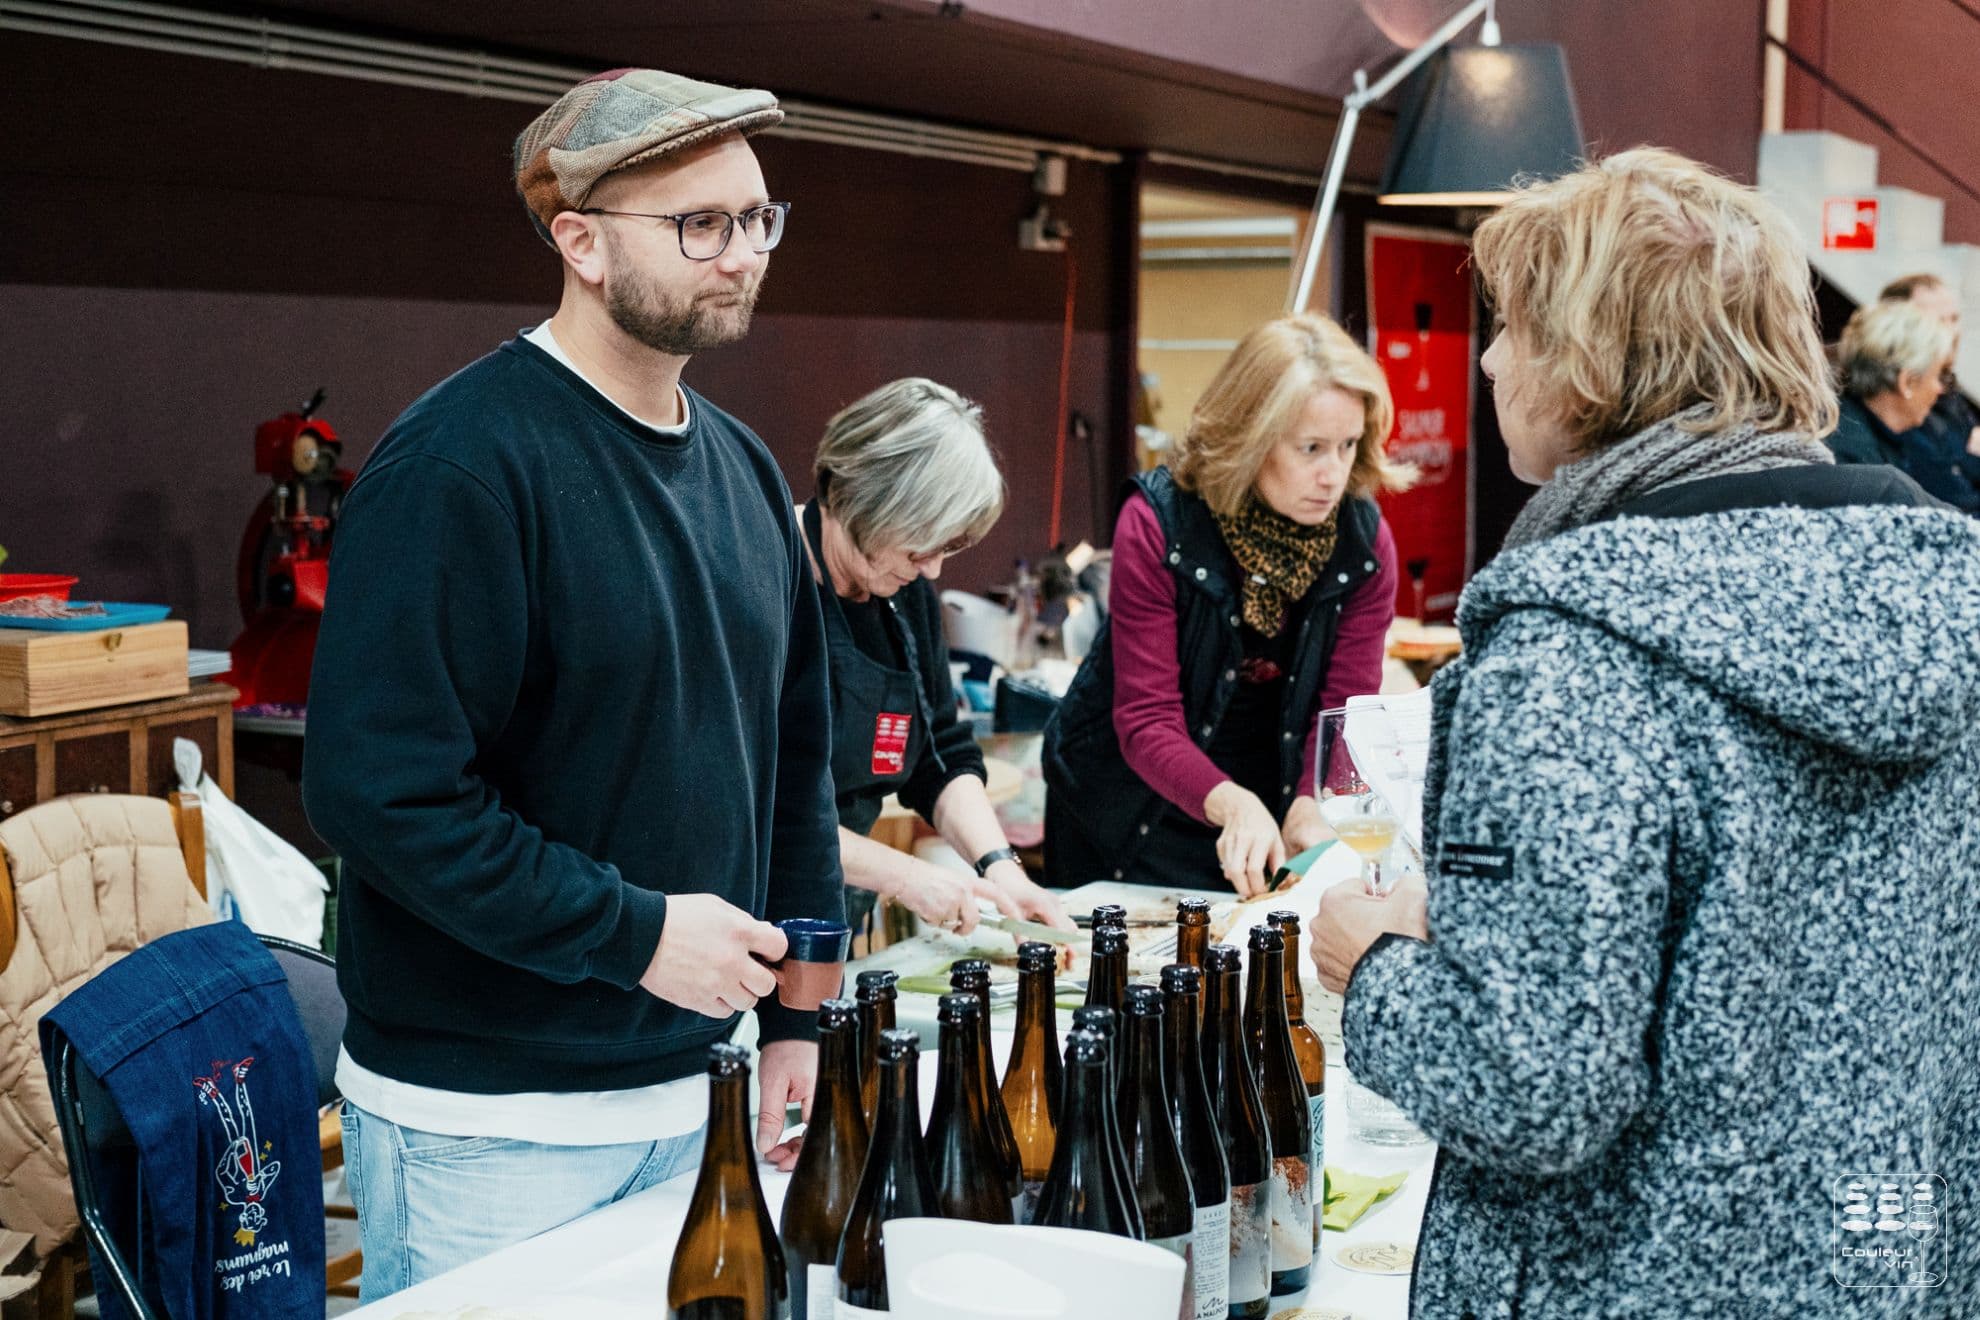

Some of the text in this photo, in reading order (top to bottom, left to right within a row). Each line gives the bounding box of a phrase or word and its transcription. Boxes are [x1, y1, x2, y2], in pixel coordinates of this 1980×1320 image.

[214, 1240, 289, 1272] magnums
[220, 1259, 290, 1293] Le roi des
